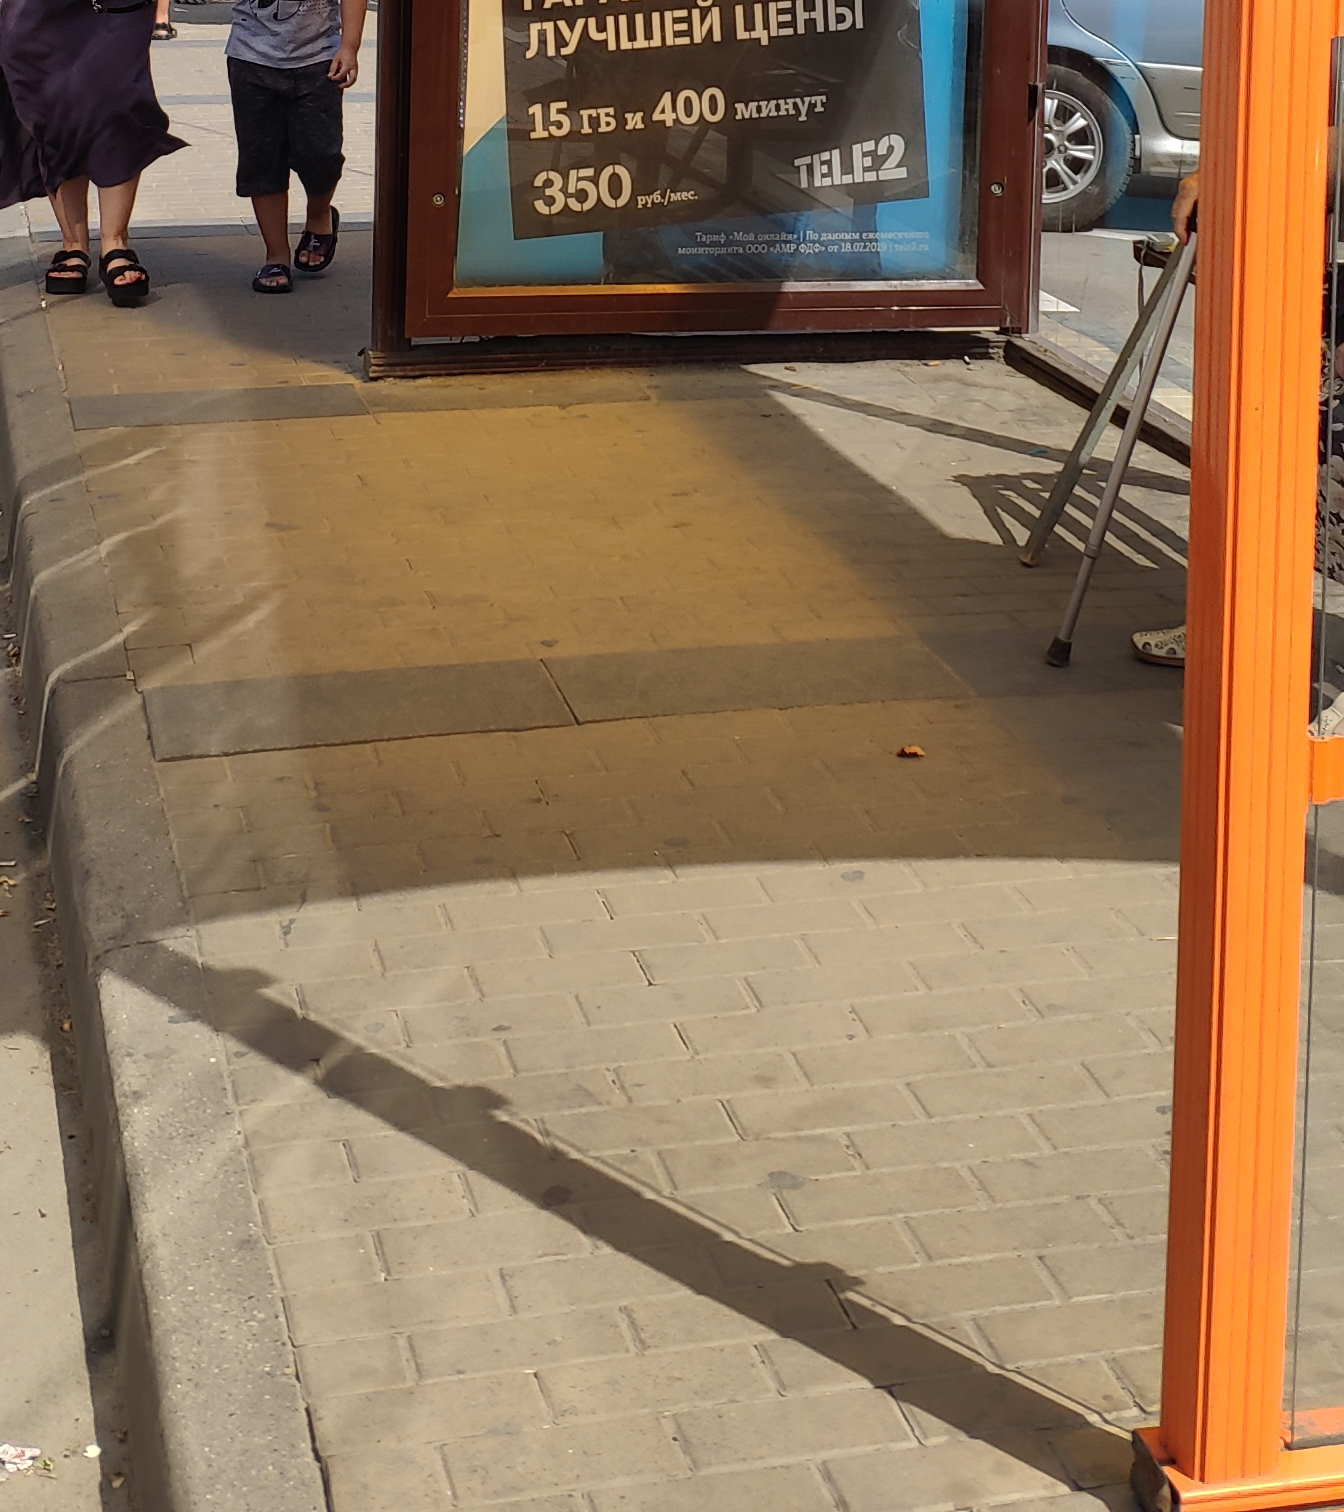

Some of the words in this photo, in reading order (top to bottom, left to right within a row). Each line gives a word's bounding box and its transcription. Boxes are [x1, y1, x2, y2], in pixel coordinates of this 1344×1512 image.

[524, 0, 723, 60] ЛУЧШЕЙ
[528, 102, 572, 140] 15
[579, 105, 617, 136] ГБ
[624, 110, 645, 132] и
[652, 86, 726, 129] 400
[734, 92, 828, 123] минут
[794, 133, 909, 189] TELE2
[532, 163, 633, 216] 350
[637, 187, 699, 209] руб./мес.
[677, 244, 744, 256] мониторинга
[828, 244, 838, 253] от
[695, 231, 727, 244] Тариф
[806, 230, 819, 241] По
[820, 230, 860, 242] данным
